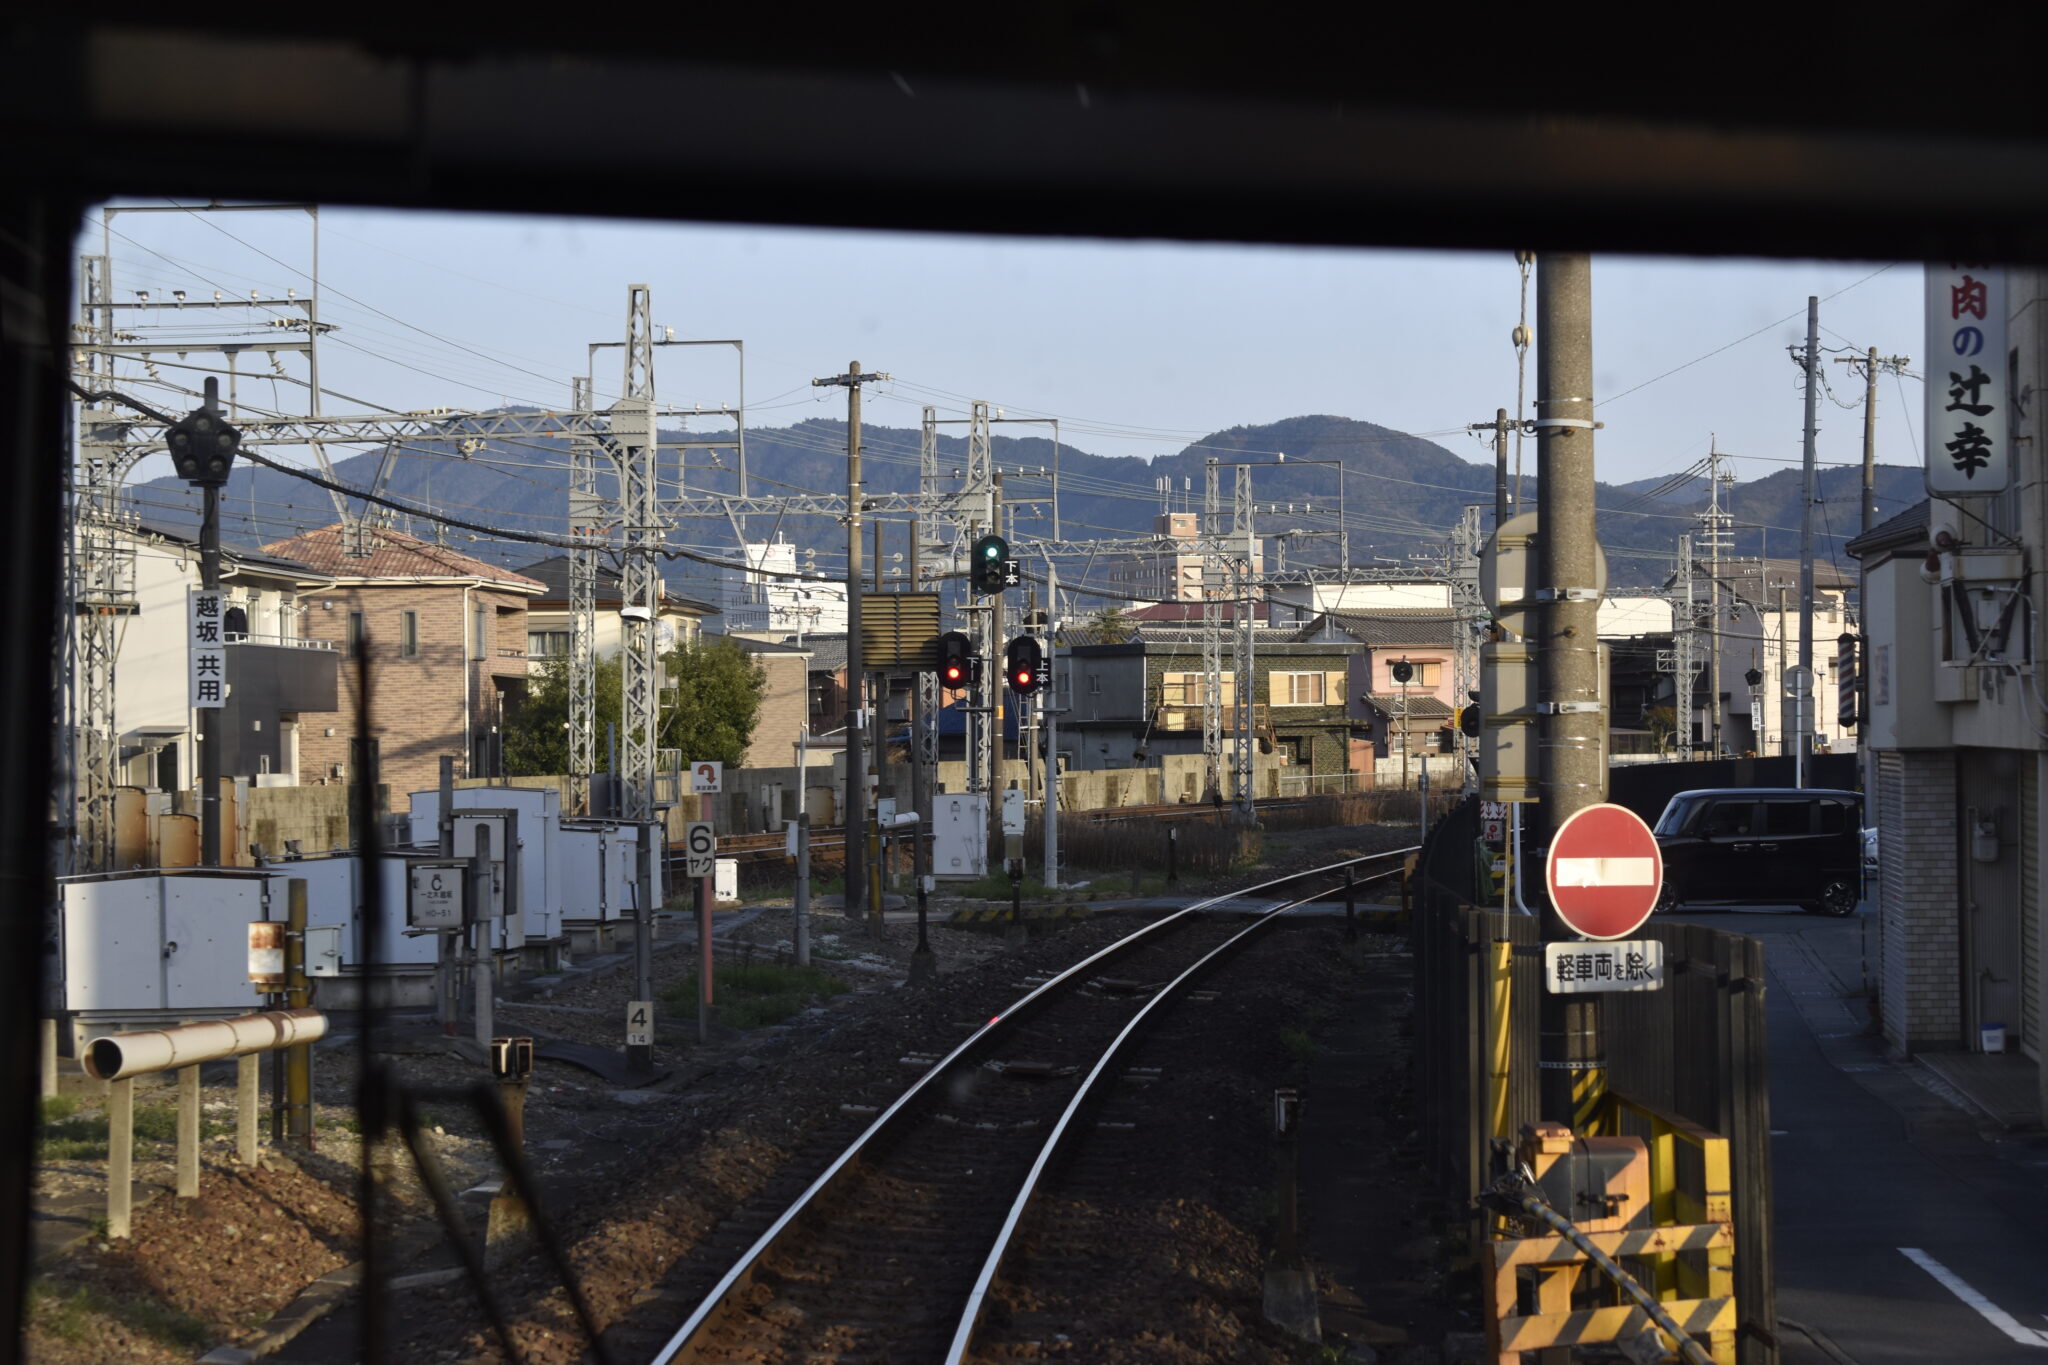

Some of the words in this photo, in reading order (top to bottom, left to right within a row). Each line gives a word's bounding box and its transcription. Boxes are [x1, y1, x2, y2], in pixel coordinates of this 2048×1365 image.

[1945, 263, 1994, 480] 肉の辻幸
[1004, 560, 1018, 585] 下本
[196, 595, 219, 642] 越坂
[197, 655, 220, 701] 共用
[1036, 660, 1048, 684] 上本
[689, 825, 711, 854] 6
[689, 857, 712, 873] ヤク
[431, 876, 442, 891] C
[1556, 952, 1654, 982] 軽車両を除く
[631, 1007, 648, 1028] 4
[632, 1034, 645, 1043] 14
